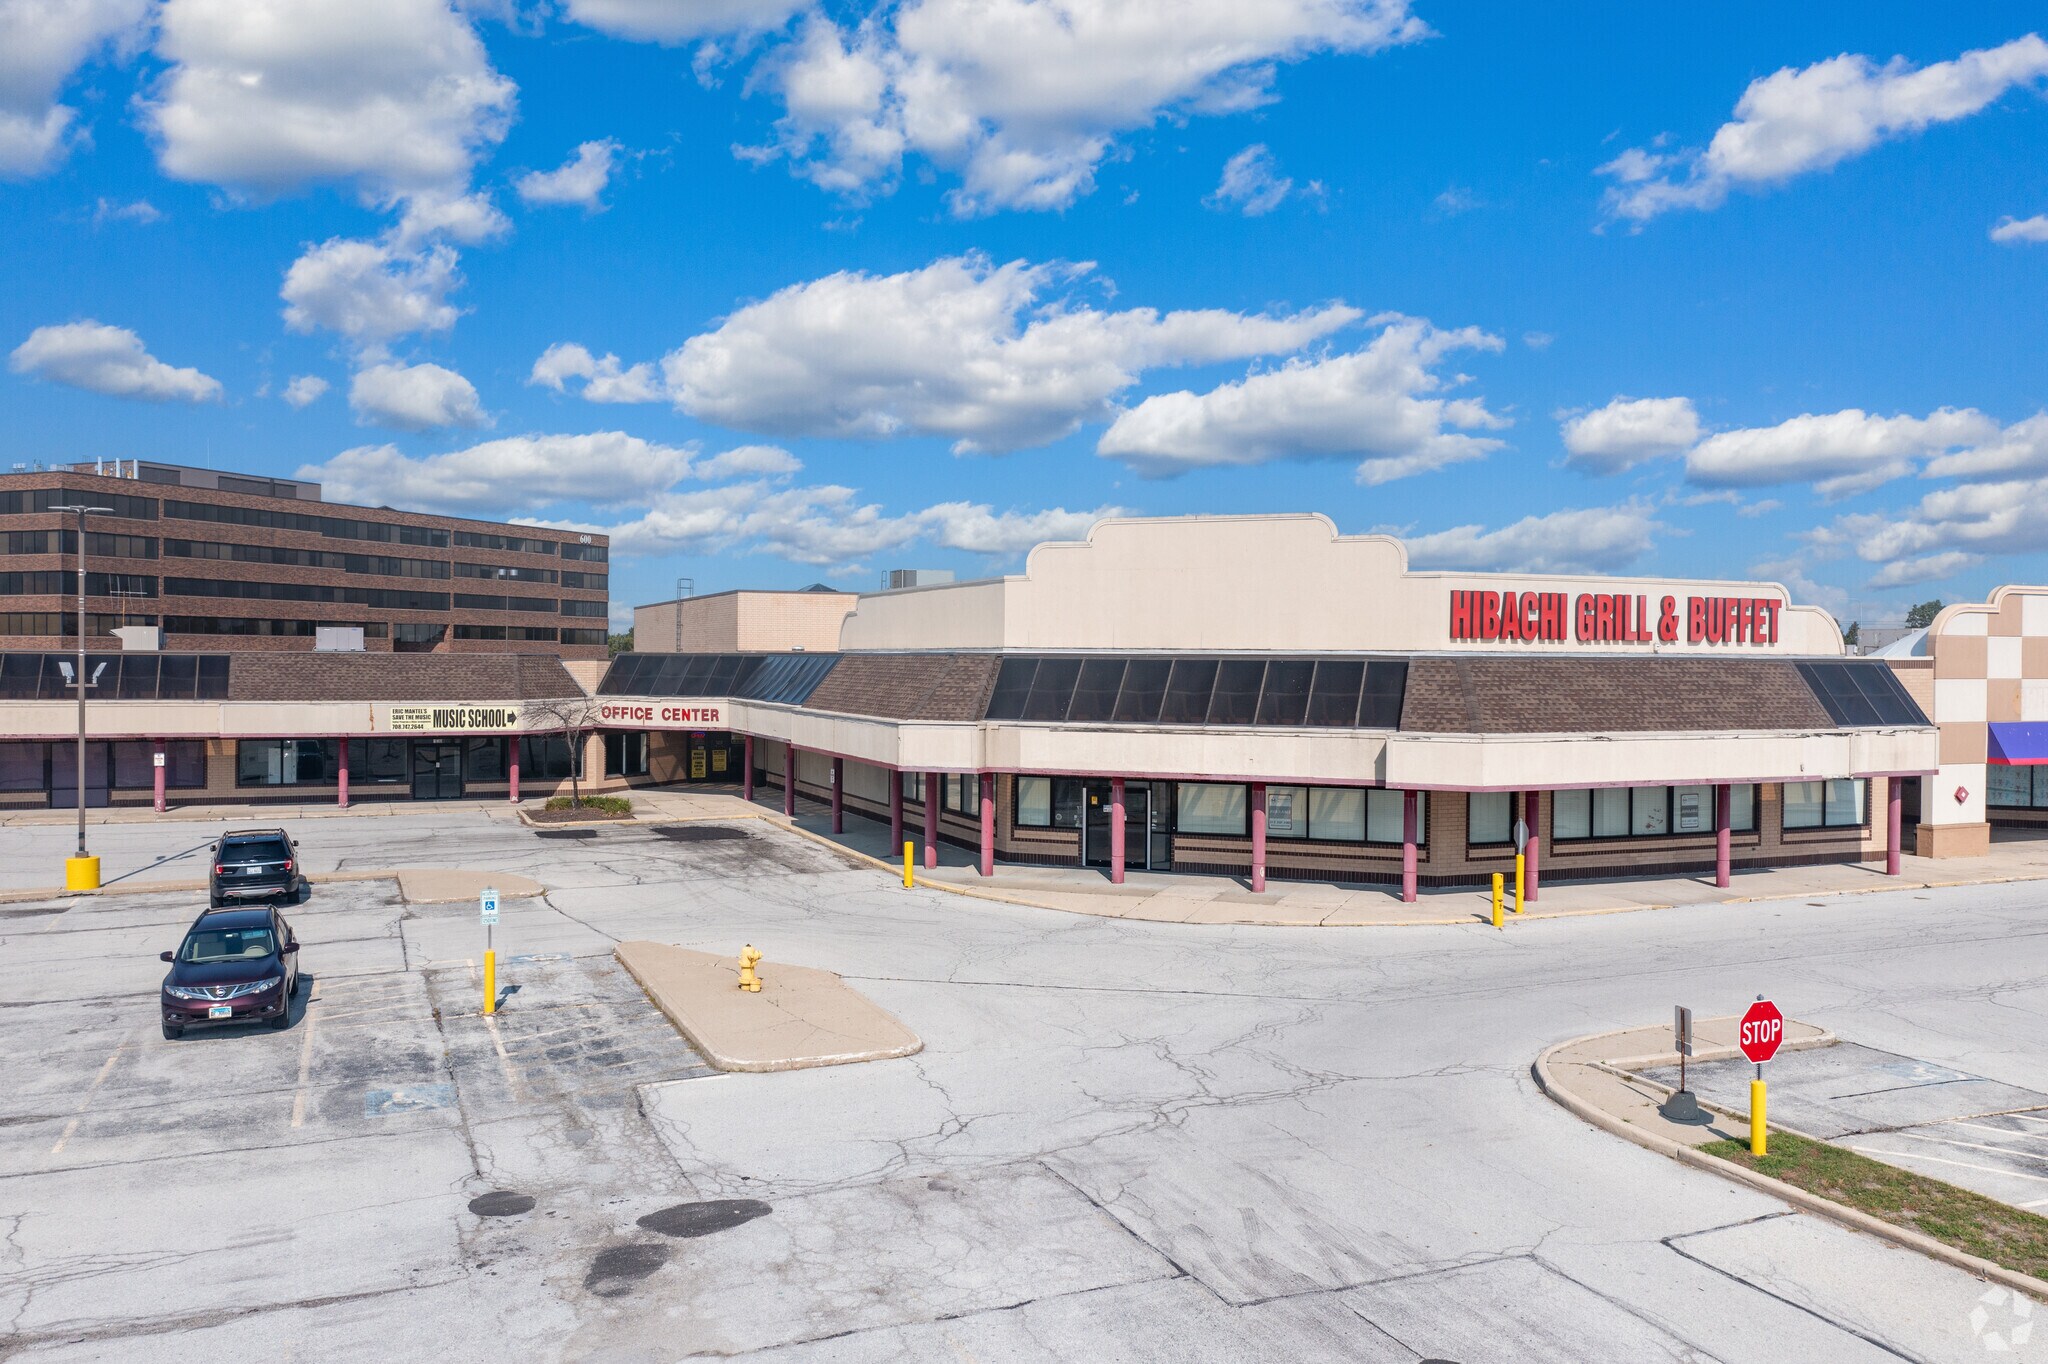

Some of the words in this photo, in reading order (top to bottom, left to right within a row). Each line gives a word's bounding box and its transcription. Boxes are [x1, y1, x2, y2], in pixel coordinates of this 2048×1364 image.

[580, 534, 592, 544] 600
[1450, 590, 1568, 640] HIBACHI
[1575, 593, 1653, 641] GRILL
[1658, 595, 1679, 641] &
[1687, 597, 1783, 643] BUFFET
[433, 709, 466, 728] MUSIC
[468, 708, 507, 728] SCHOOL
[601, 705, 654, 720] OFFICE
[661, 707, 719, 722] CENTER
[1742, 1018, 1781, 1046] STOP
